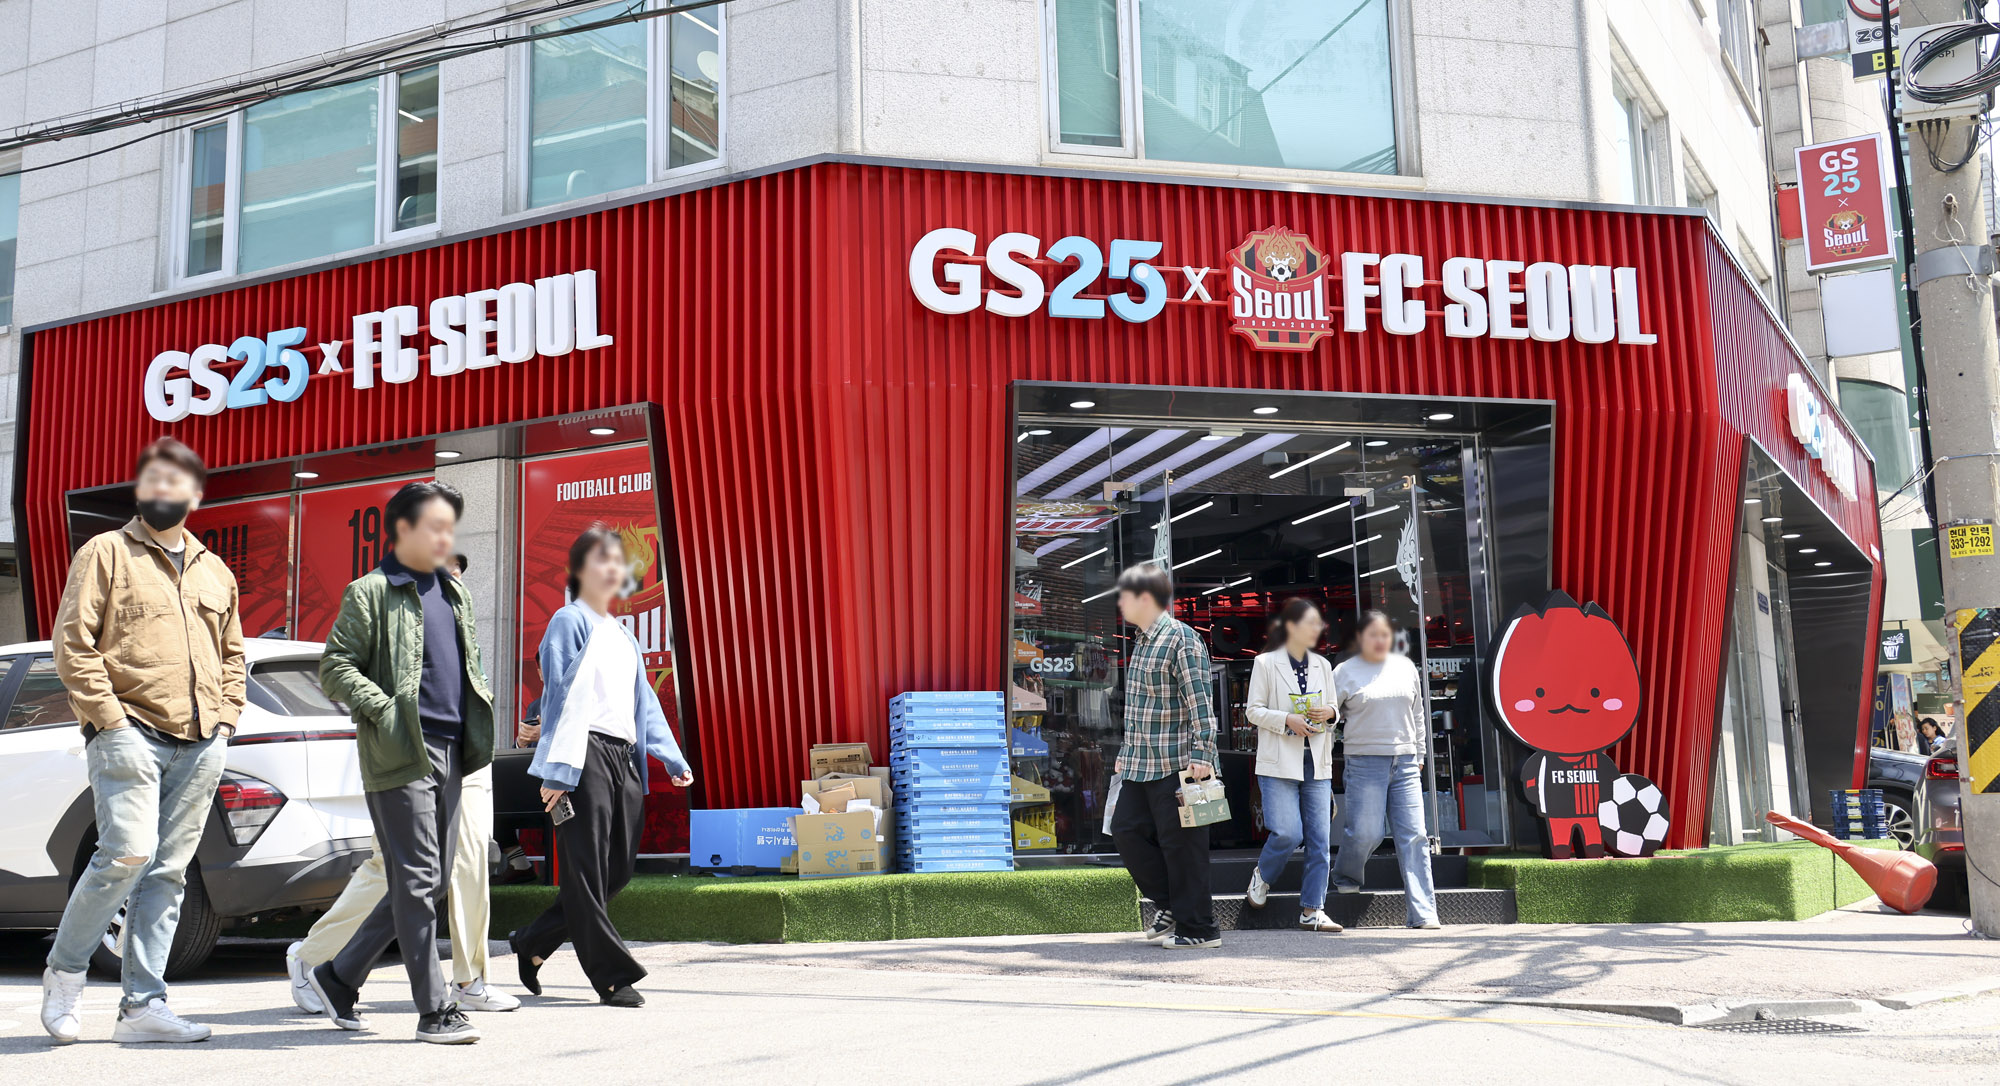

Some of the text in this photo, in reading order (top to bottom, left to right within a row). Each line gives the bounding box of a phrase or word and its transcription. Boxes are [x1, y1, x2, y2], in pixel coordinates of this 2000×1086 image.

[1819, 148, 1859, 173] GS
[1822, 170, 1861, 197] 25
[909, 227, 1168, 323] GS25
[1341, 251, 1426, 335] FC
[1442, 256, 1657, 345] SEOUL
[144, 326, 309, 422] GS25
[353, 305, 419, 389] FC
[430, 269, 613, 377] SEOUL
[557, 472, 652, 501] FOOTBALL CLUB
[1951, 536, 1991, 550] 333-1292
[1030, 657, 1075, 672] GS25
[1552, 769, 1599, 783] FC SEOUL
